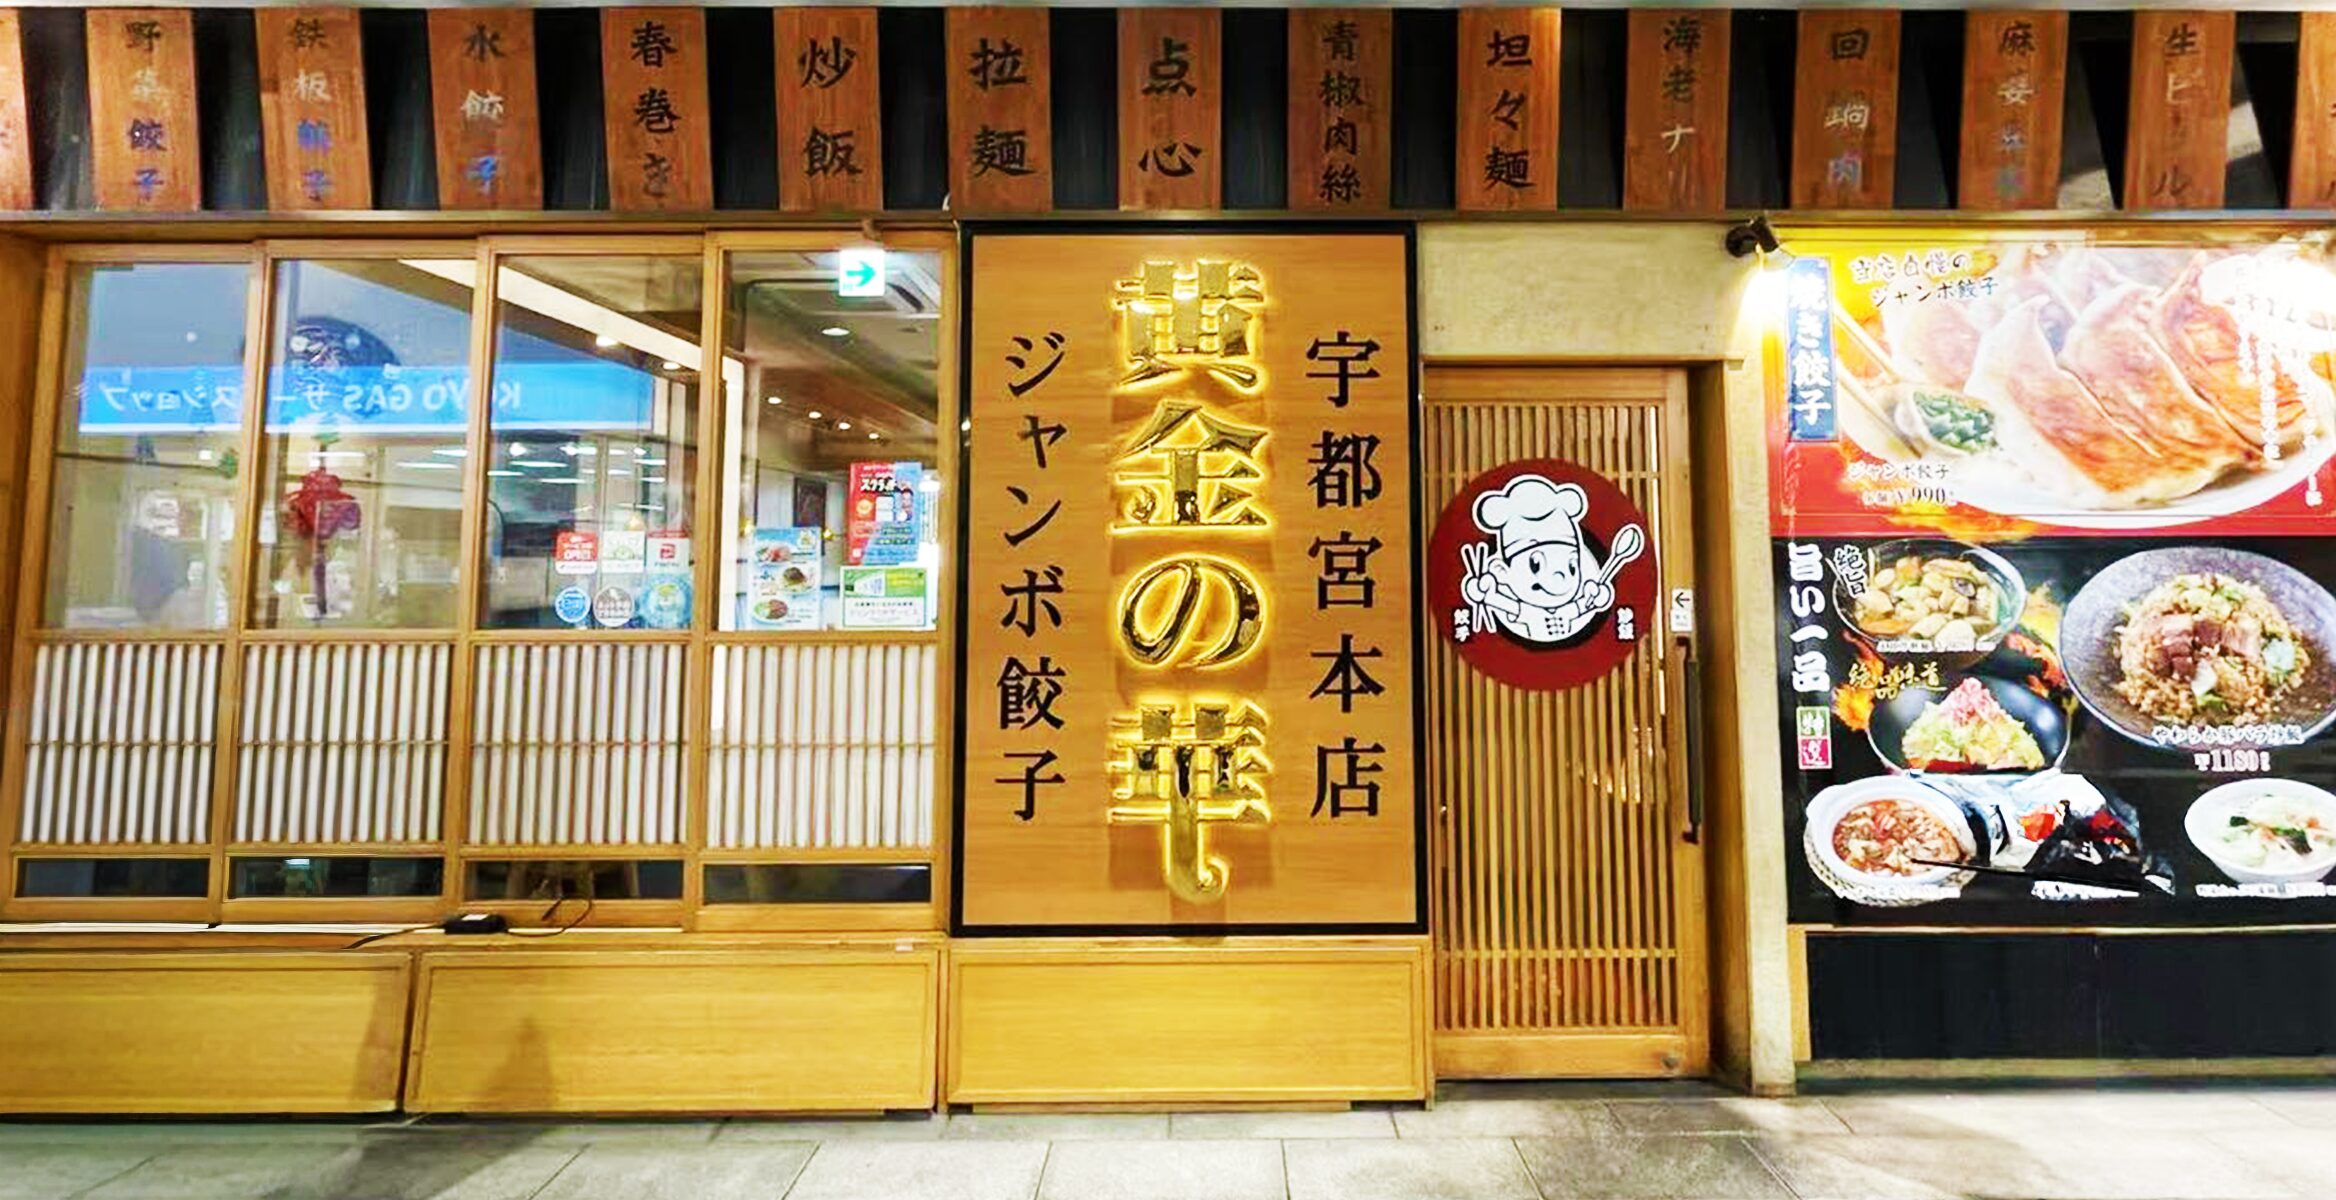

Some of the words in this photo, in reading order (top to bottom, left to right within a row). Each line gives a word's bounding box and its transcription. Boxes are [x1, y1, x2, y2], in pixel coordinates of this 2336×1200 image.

[630, 20, 682, 199] 春巻き
[799, 37, 863, 178] 炒飯
[969, 37, 1038, 178] 拉麺
[1138, 36, 1203, 178] 点心
[1318, 20, 1364, 203] 青椒肉絲
[1872, 276, 1999, 308] ジャンボ餃子
[994, 332, 1068, 822] ジャンボ餃子
[1108, 259, 1271, 901] 黄金の華
[1306, 332, 1386, 819] 宇都宮本店
[1788, 542, 1830, 693] 旨い一品
